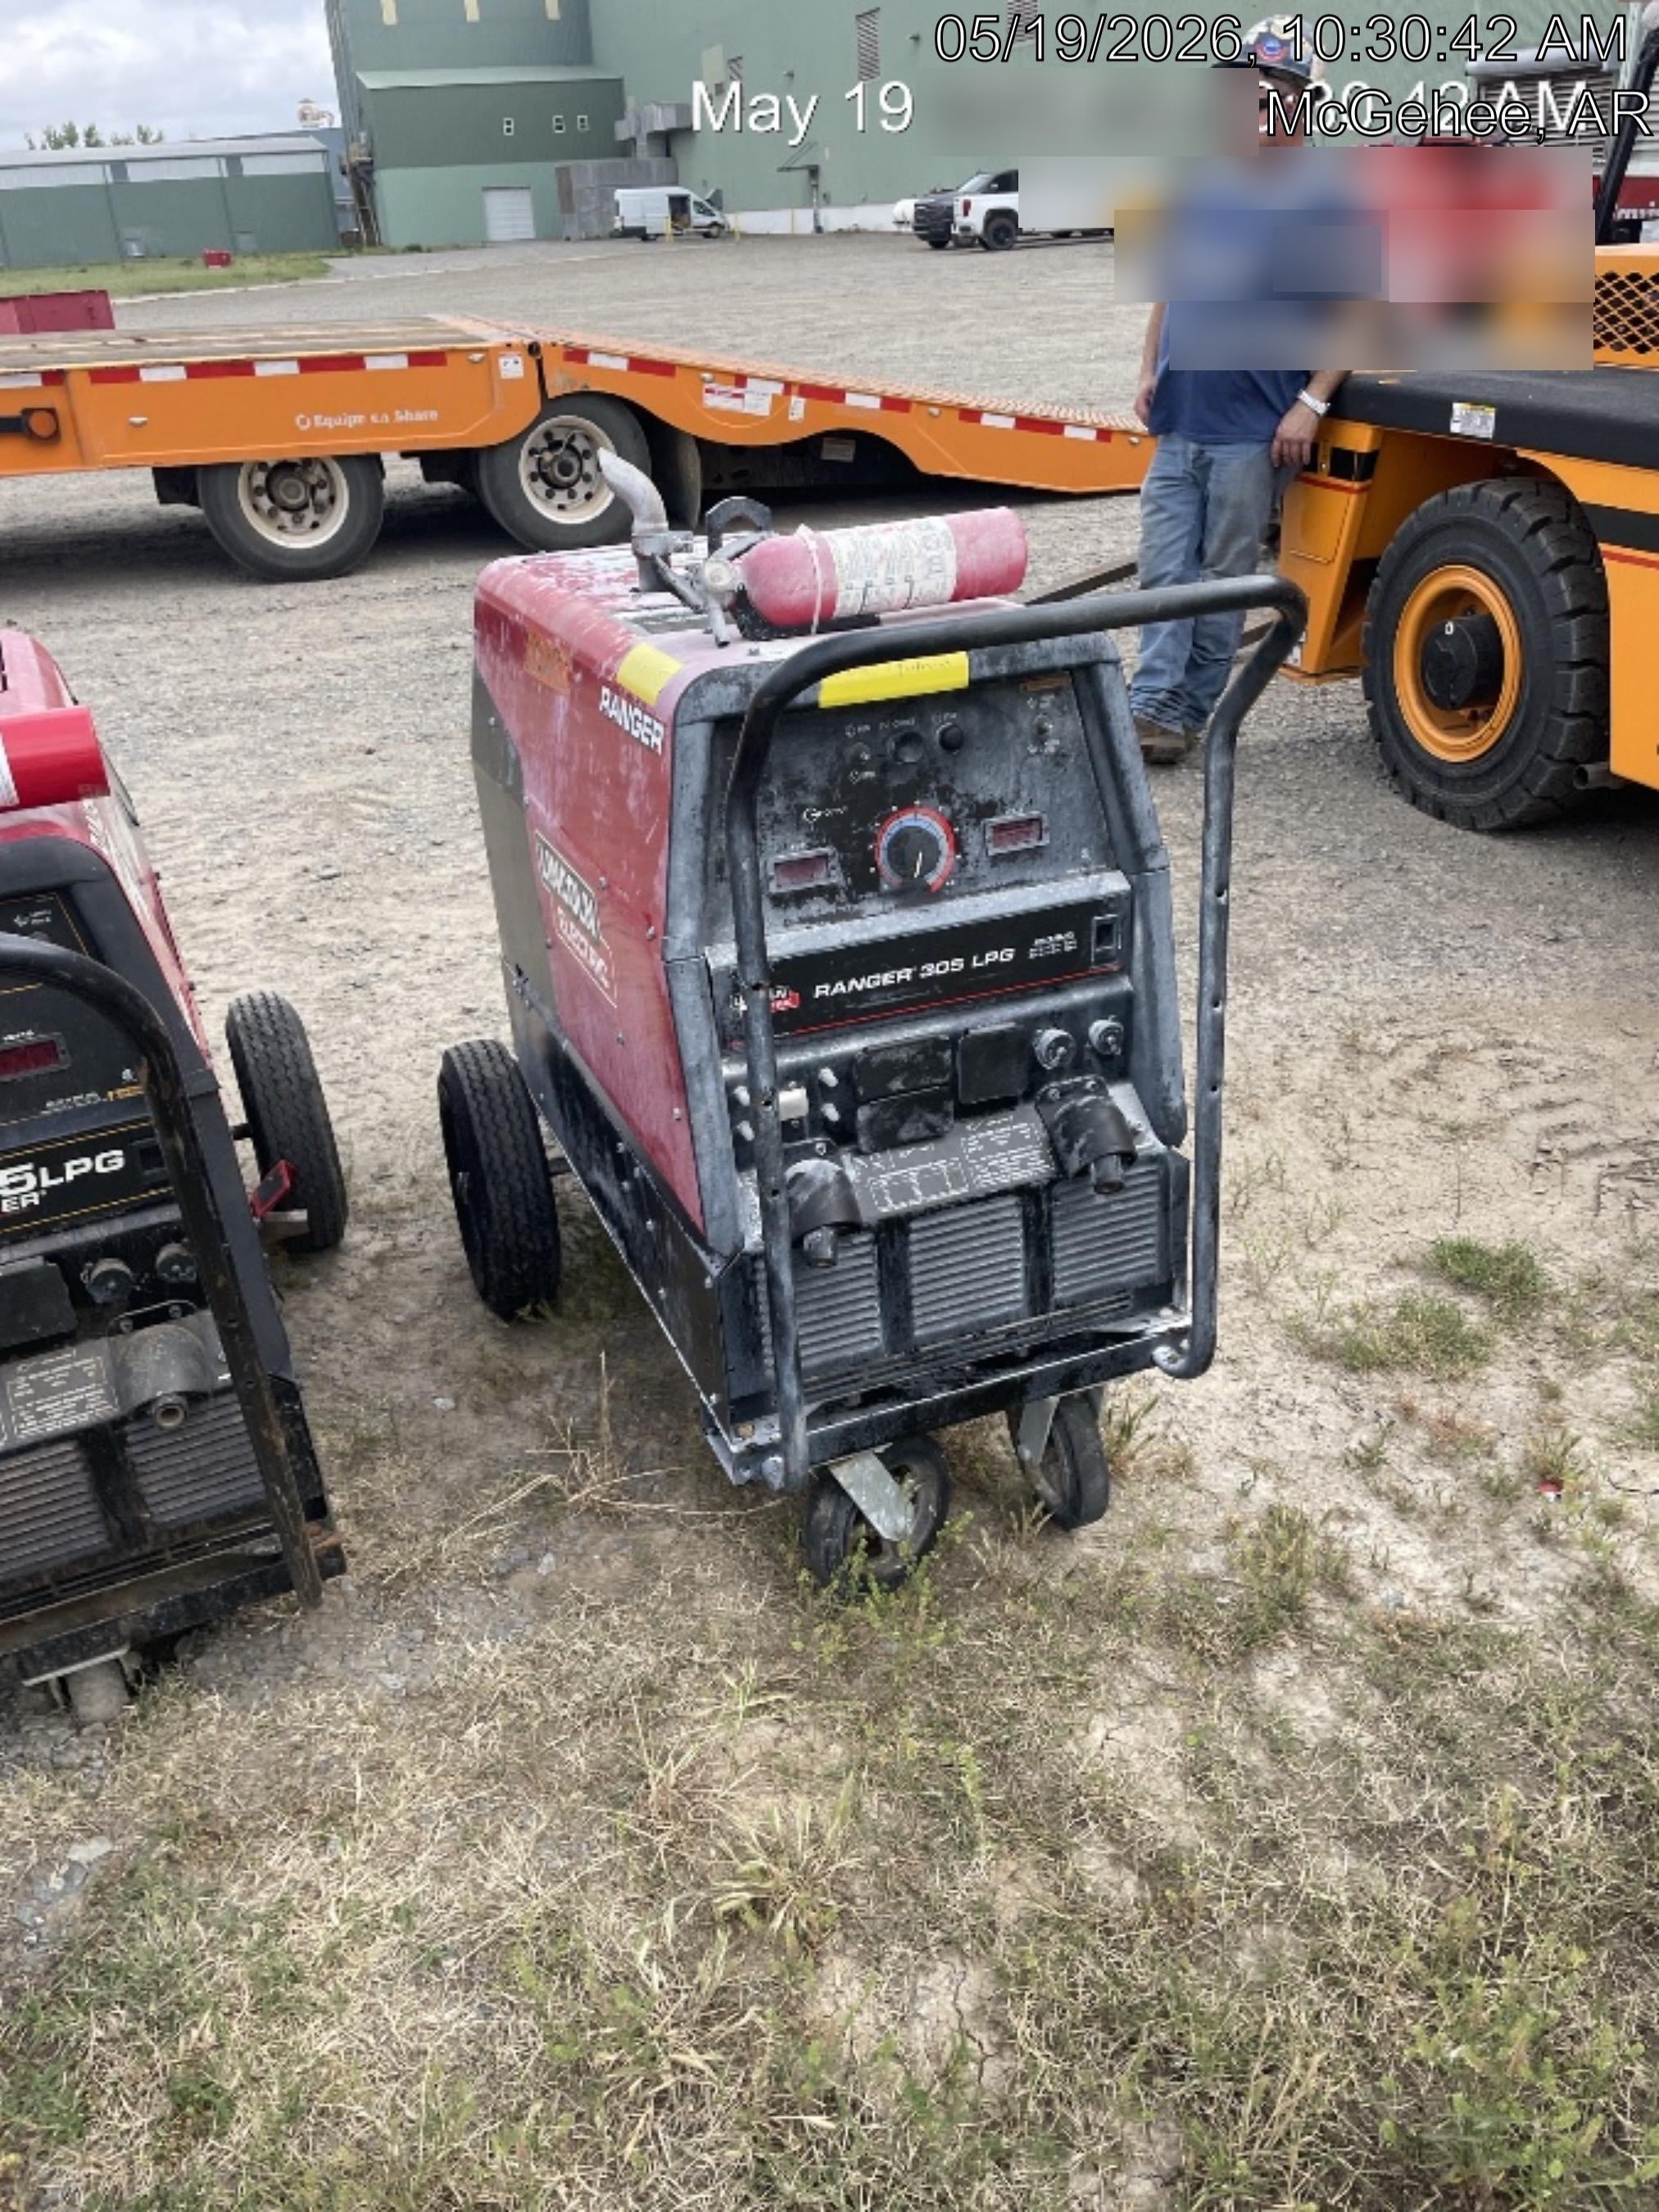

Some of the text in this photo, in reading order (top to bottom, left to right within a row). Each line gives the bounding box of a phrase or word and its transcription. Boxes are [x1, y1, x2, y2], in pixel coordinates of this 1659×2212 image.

[599, 684, 665, 755] RANGER
[813, 948, 1016, 999] RANGER 305 LPG
[39, 1149, 125, 1188] LPG
